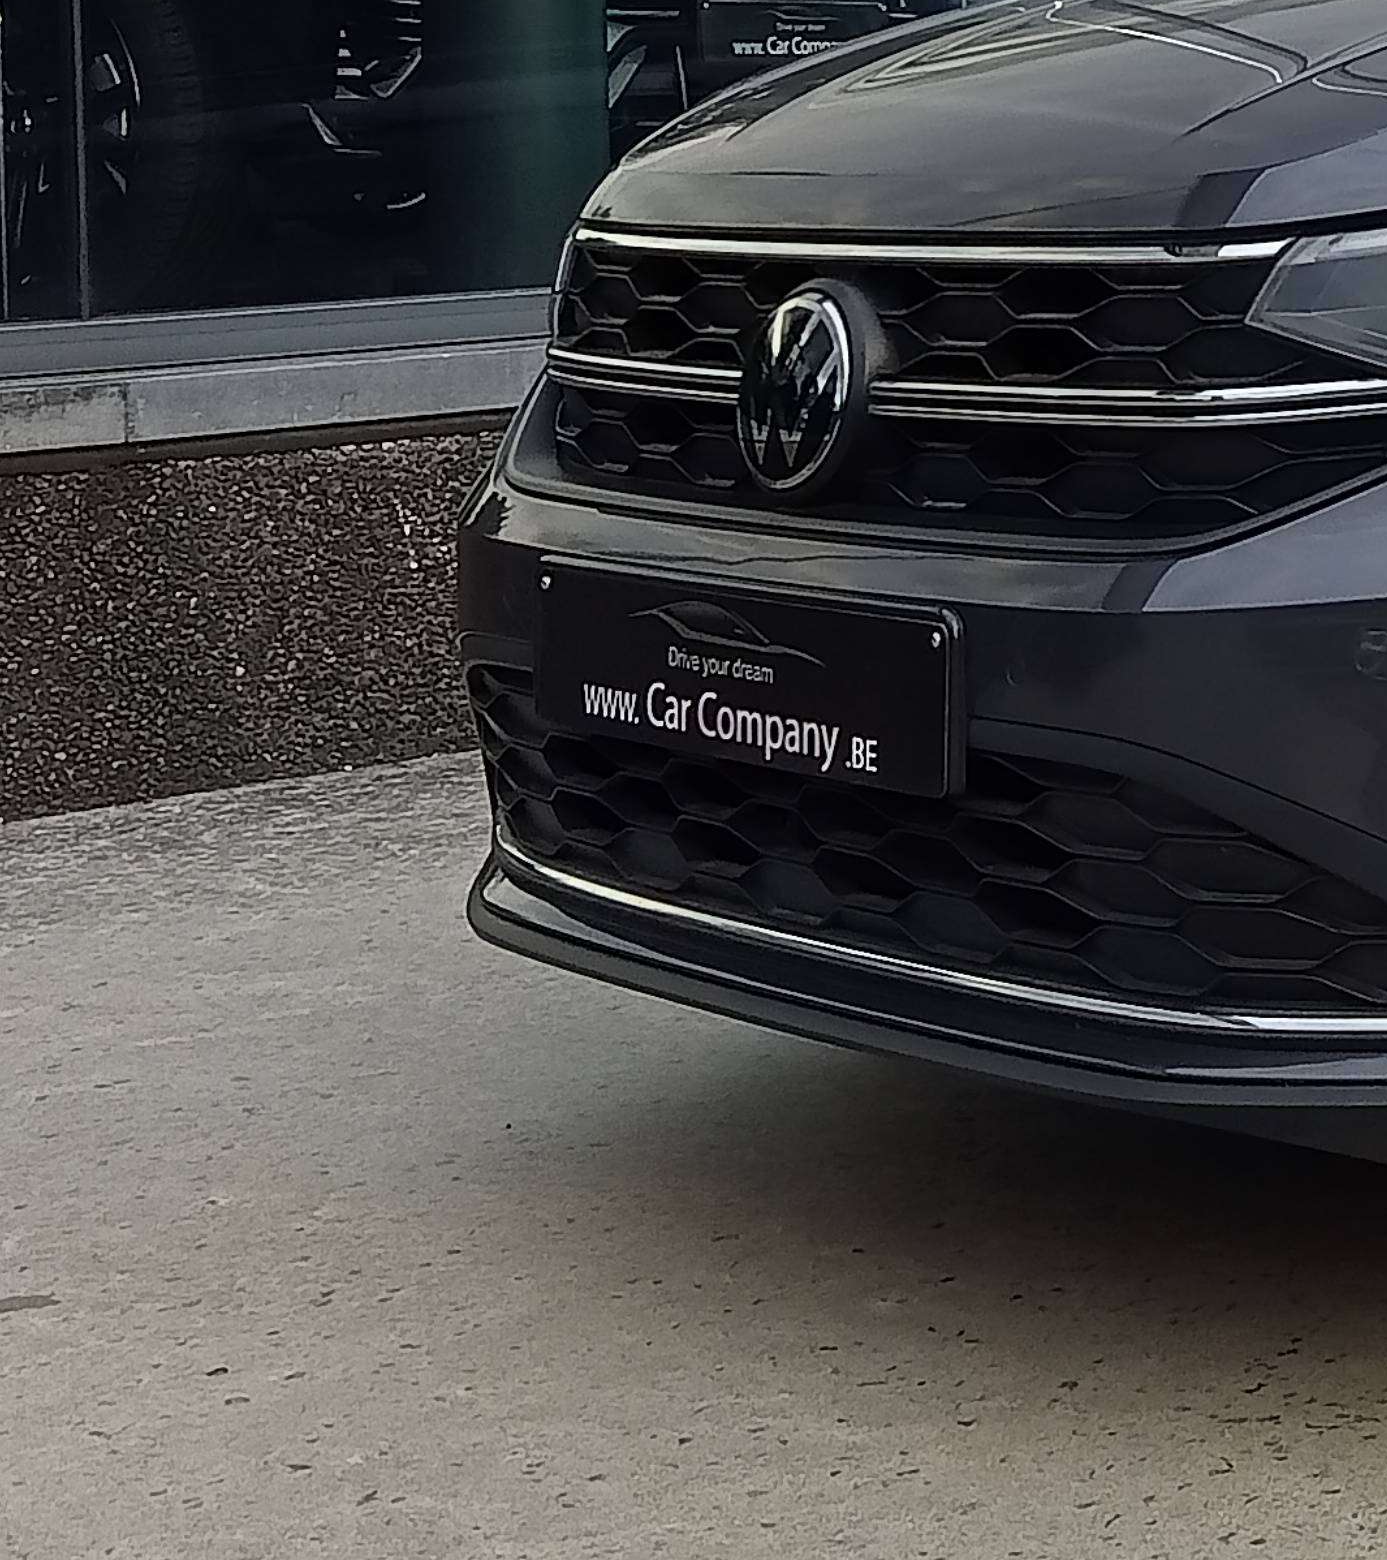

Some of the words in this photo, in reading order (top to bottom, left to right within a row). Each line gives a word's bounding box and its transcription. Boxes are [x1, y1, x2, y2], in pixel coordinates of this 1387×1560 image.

[767, 36, 789, 55] Car
[668, 645, 700, 671] Drive
[701, 654, 731, 679] your
[732, 658, 774, 685] dream
